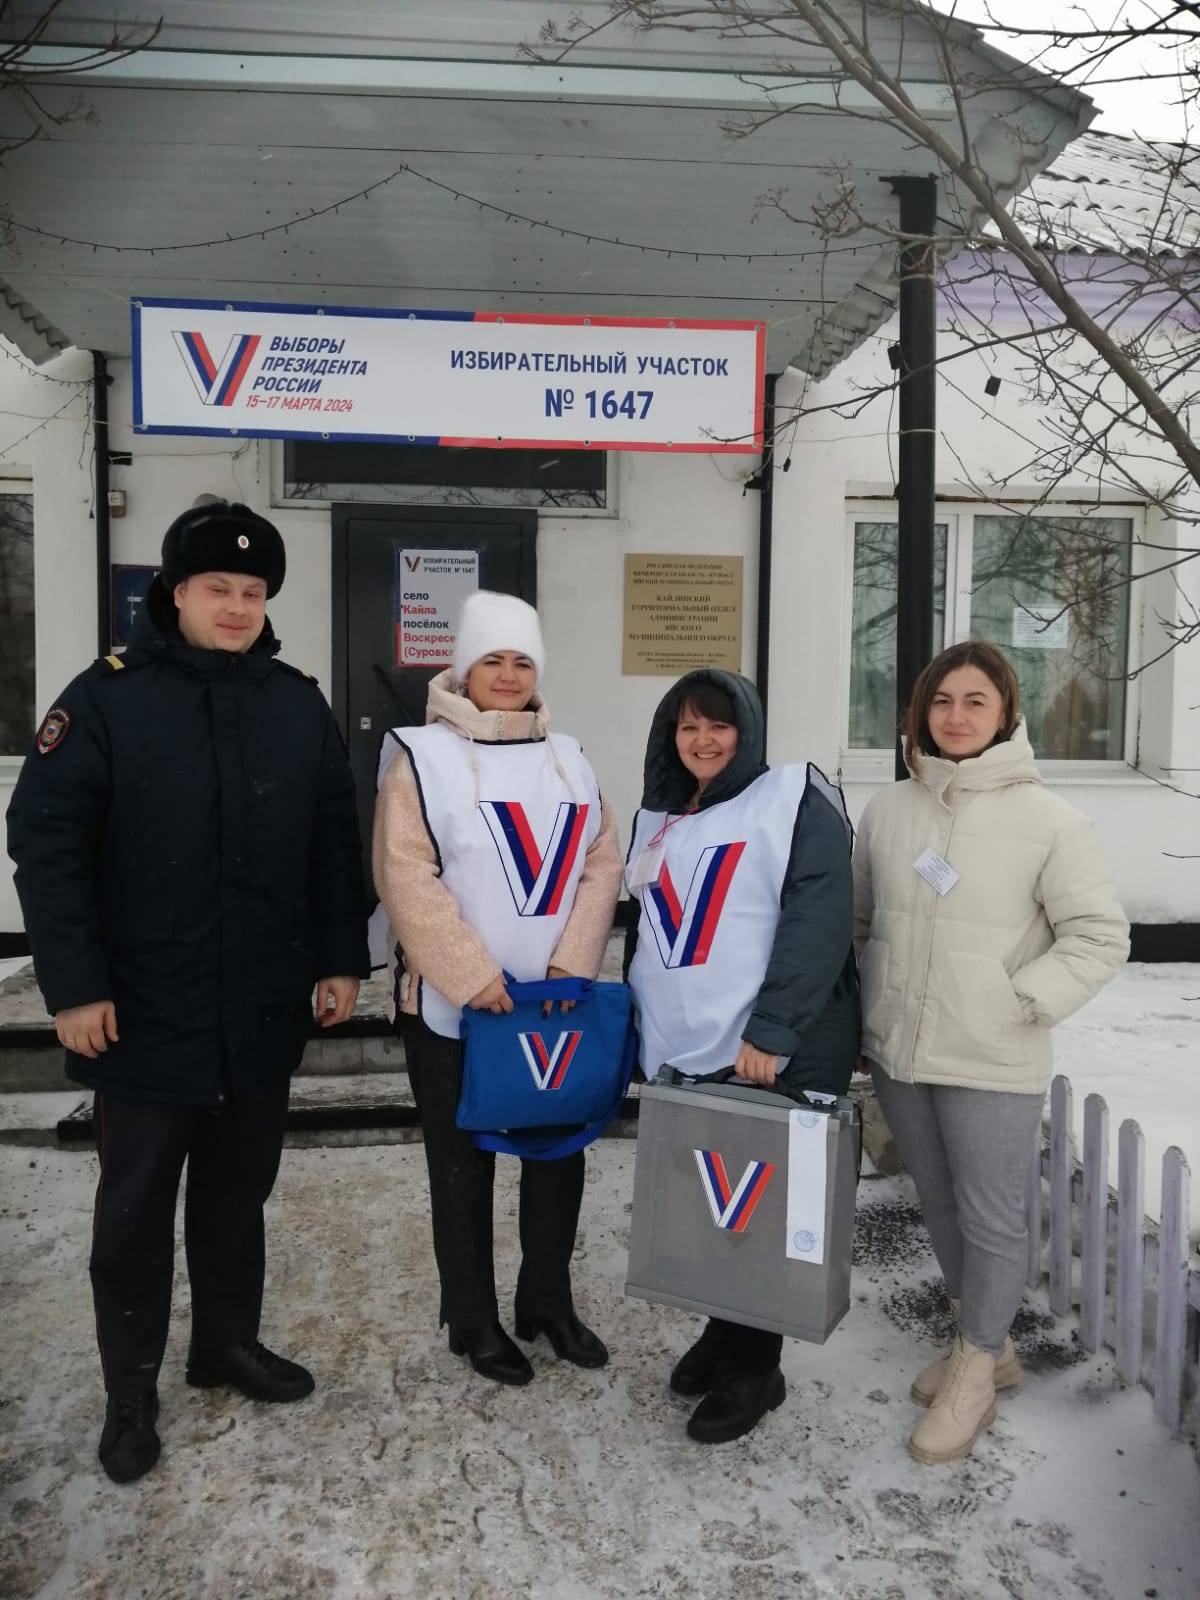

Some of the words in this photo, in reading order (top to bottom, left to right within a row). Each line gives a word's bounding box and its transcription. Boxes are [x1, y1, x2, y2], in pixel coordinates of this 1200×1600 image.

[269, 336, 346, 355] ВЫБОРЫ
[260, 356, 368, 377] ПРЕЗИДЕНТА
[450, 350, 627, 374] ИЗБИРАТЕЛЬНЫЙ
[637, 356, 729, 377] УЧАСТОК
[252, 376, 322, 394] РОССИИ
[280, 397, 322, 412] МАРТА
[323, 399, 353, 413] 2024
[545, 388, 575, 418] №
[584, 390, 654, 420] 1647
[423, 557, 476, 565] ИЗБИРАТЕЛЬНЫЙ
[403, 592, 430, 601] село
[403, 604, 437, 615] Кайла
[403, 618, 450, 629] посёлок
